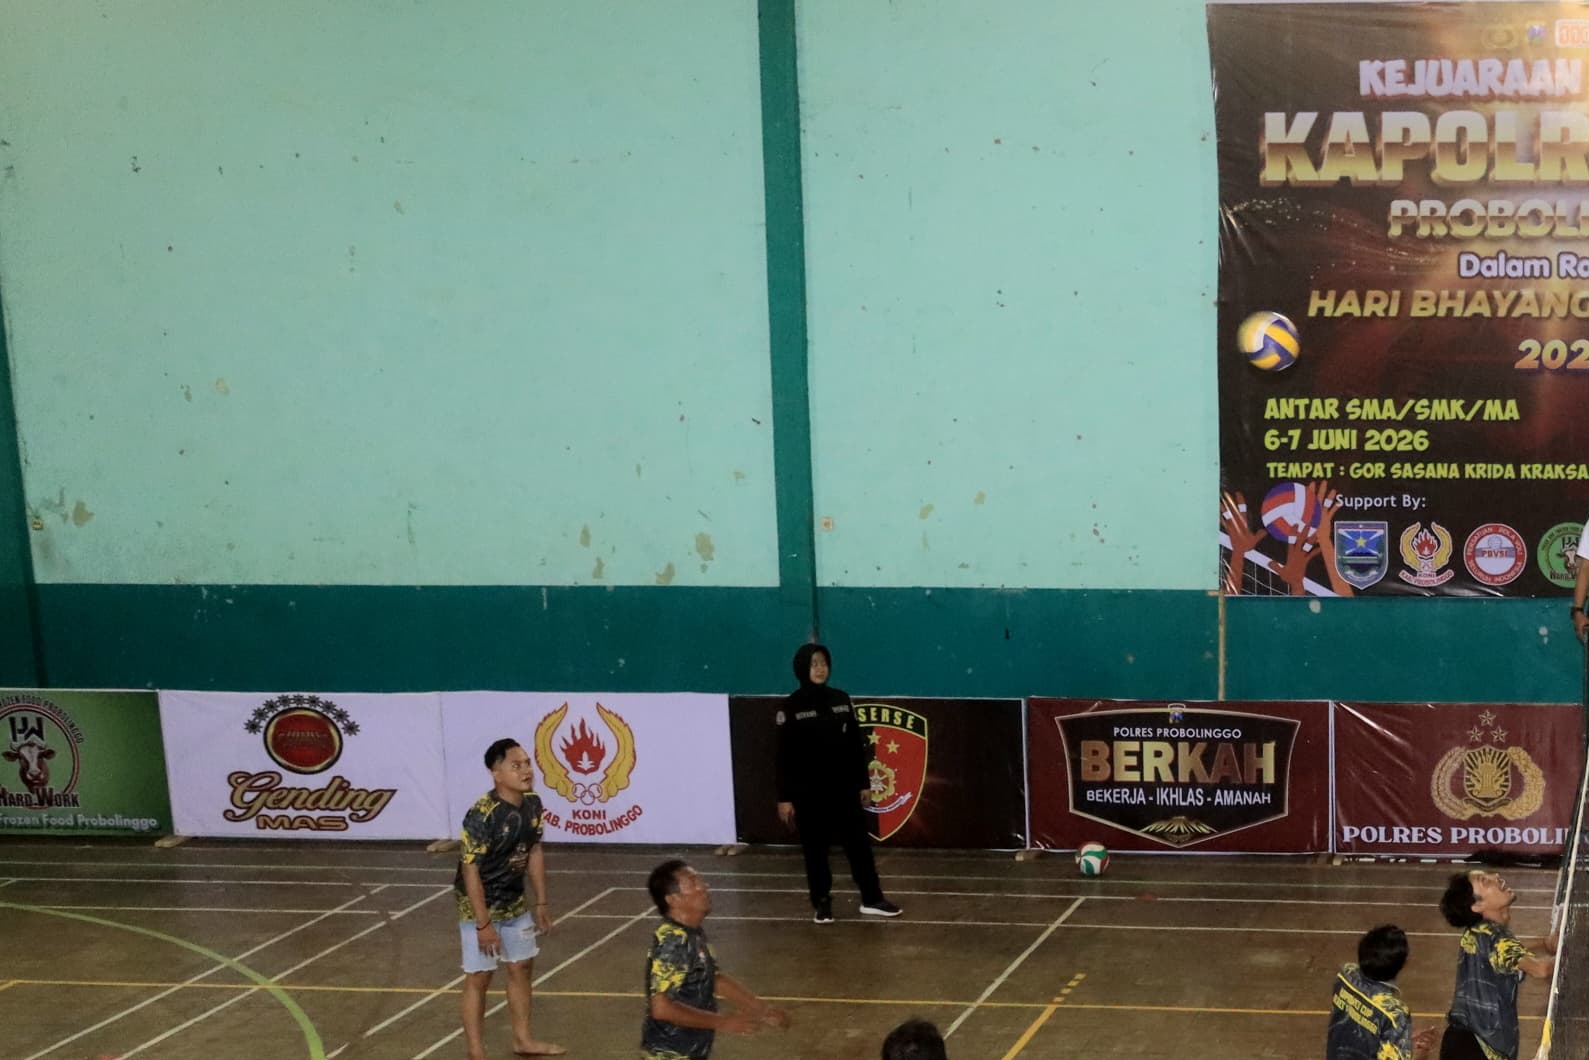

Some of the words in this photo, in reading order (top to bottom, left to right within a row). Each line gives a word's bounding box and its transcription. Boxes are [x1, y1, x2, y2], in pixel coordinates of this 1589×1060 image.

[1359, 59, 1581, 97] KEJUARAAN
[1459, 252, 1551, 279] Dalam
[1307, 290, 1399, 318] HARI
[1264, 398, 1340, 421] ANTAR
[1345, 398, 1520, 422] SMA/SMK/MA
[1264, 429, 1301, 451] 6-7
[1307, 429, 1357, 451] JUNI
[1364, 429, 1429, 451] 2026
[1266, 462, 1335, 479] TEMPAT
[1349, 463, 1385, 480] GOR
[1390, 463, 1460, 480] SASANA
[1464, 463, 1515, 480] KRIDA
[1335, 494, 1397, 510] Support
[1402, 494, 1427, 511] By:
[858, 707, 915, 729] SERSE
[1113, 727, 1153, 738] POLRES
[1156, 728, 1242, 739] PROBOLINGGO
[1081, 740, 1276, 784] BERKAH
[223, 771, 398, 823] Gending
[1086, 787, 1146, 805] BEKERJA
[1156, 788, 1204, 806] IKHLAS
[1214, 788, 1271, 806] AMANAH
[0, 814, 39, 825] rozen
[42, 813, 74, 826] Food
[77, 813, 157, 830] Probolinggo
[256, 814, 349, 831] MAS
[543, 808, 561, 829] AB.
[564, 805, 643, 836] PROBOLINGGO
[572, 809, 606, 820] KONI
[1342, 825, 1442, 845] POLRES
